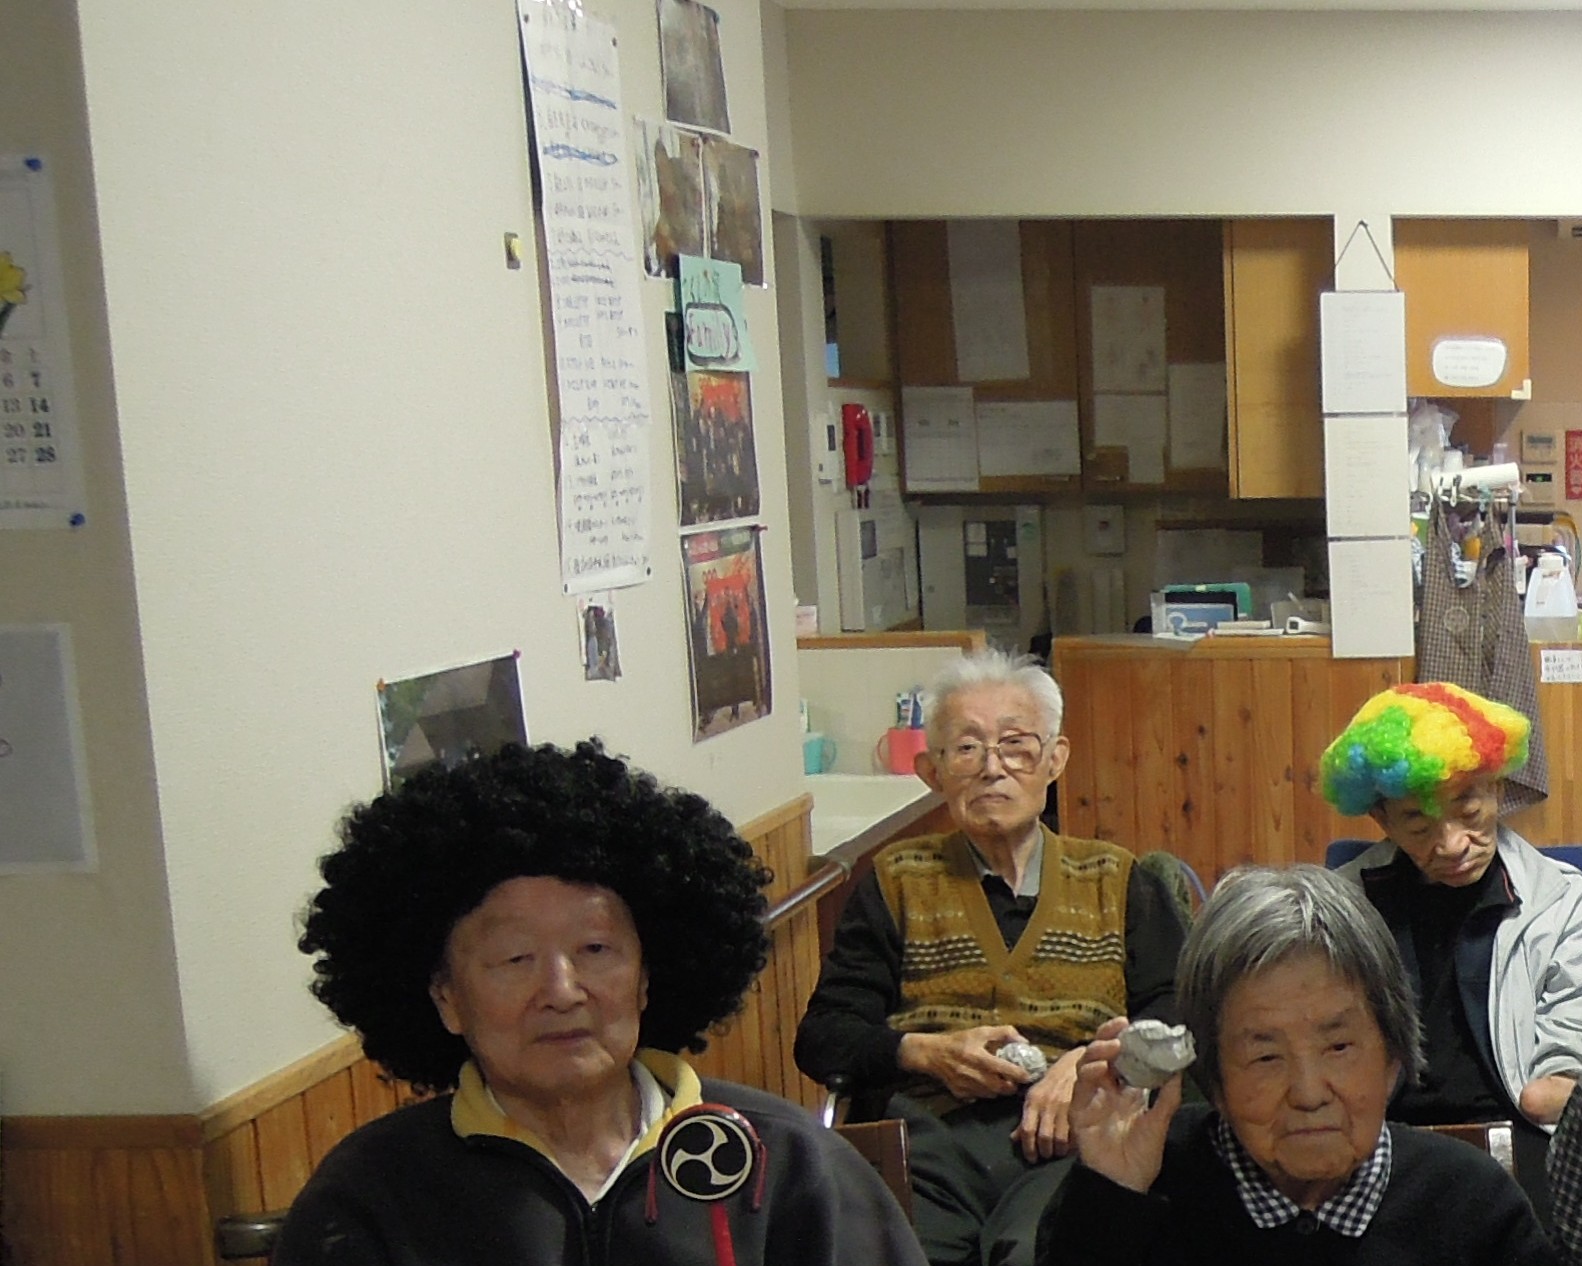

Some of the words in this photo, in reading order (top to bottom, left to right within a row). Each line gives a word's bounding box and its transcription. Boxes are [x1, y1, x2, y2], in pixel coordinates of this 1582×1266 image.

[31, 371, 40, 388] 7
[3, 398, 21, 413] 13
[30, 397, 48, 413] 14
[4, 423, 25, 438] 20
[33, 422, 51, 437] 21
[7, 448, 27, 463] 27
[36, 446, 56, 463] 28
